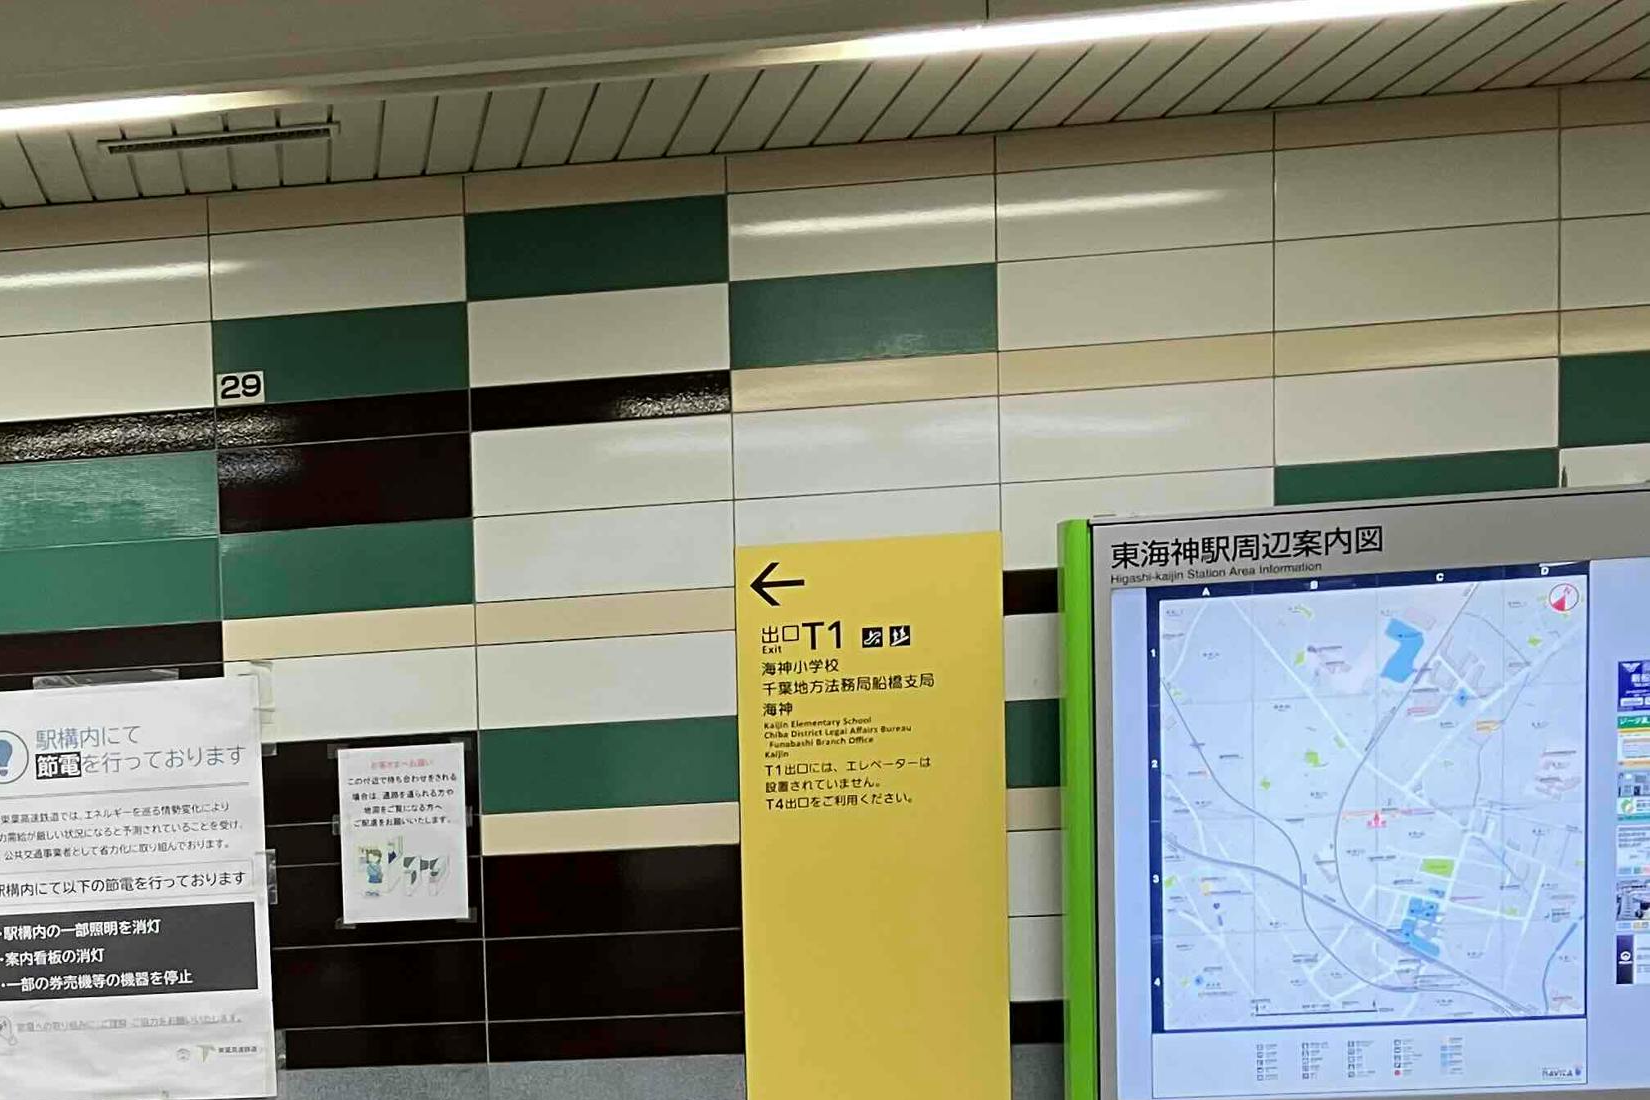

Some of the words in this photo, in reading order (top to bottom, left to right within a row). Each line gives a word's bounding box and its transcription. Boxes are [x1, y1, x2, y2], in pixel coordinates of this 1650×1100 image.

[221, 374, 261, 399] 29
[1110, 525, 1383, 569] 東海神駅周辺案内図
[1110, 571, 1184, 585] Higashi-kaijin
[1187, 567, 1226, 580] Station
[1230, 565, 1256, 577] Area
[1259, 561, 1323, 575] Information
[1436, 573, 1445, 582] C
[1541, 567, 1550, 576] D
[1202, 587, 1211, 596] A
[761, 625, 799, 643] 出口
[801, 620, 841, 650] T1
[762, 645, 782, 654] Exit
[761, 658, 839, 676] 海神小学校
[763, 673, 935, 697] 千葉地方法務局船橋支局
[763, 702, 793, 717] 海神
[764, 722, 788, 730] Kaijin
[791, 719, 841, 728] Elementary
[843, 716, 872, 725] School
[36, 725, 141, 751] 駅構内にて
[764, 731, 788, 739] Chiba
[791, 729, 822, 738] District
[825, 728, 848, 738] Legal
[850, 726, 878, 735] Affairs
[880, 725, 912, 733] Bureau
[769, 738, 814, 748] Funabashi
[816, 737, 846, 746] Branch
[848, 736, 874, 745] Office
[37, 744, 246, 778] 節電を行っております
[764, 750, 789, 759] Kaijin
[765, 777, 881, 793] 設置されていません。
[766, 792, 913, 810] T4出口をご利用ください。
